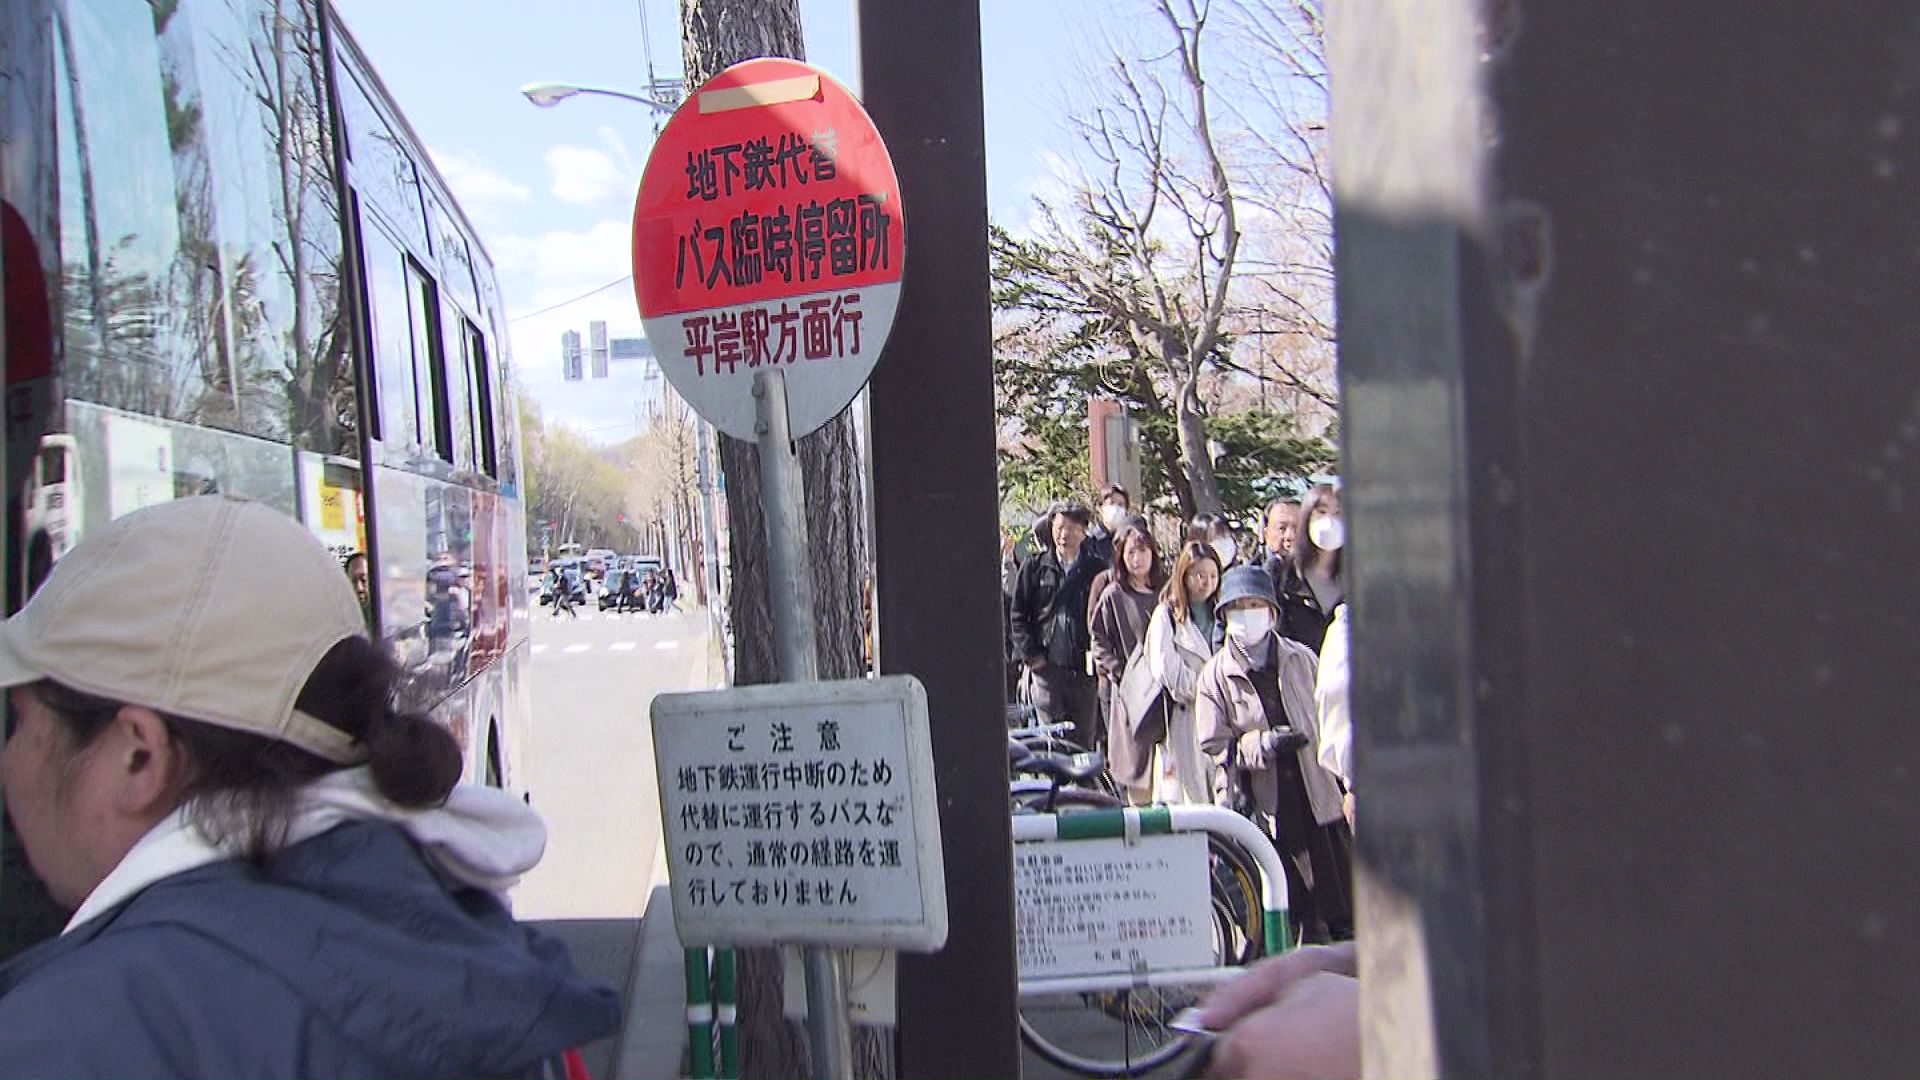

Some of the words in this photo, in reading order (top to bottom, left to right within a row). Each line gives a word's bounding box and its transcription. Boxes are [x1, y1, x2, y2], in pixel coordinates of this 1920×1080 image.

[685, 129, 837, 201] 地下鉄代替
[676, 193, 890, 289] バス臨時停留所
[683, 294, 863, 376] 平岸駅方面行
[678, 758, 892, 792] 地下鉄運行中断のため
[681, 799, 894, 831] 代替に運行するバスな
[686, 838, 901, 868] ので、通常の経路を運
[689, 878, 857, 906] 行しておりません
